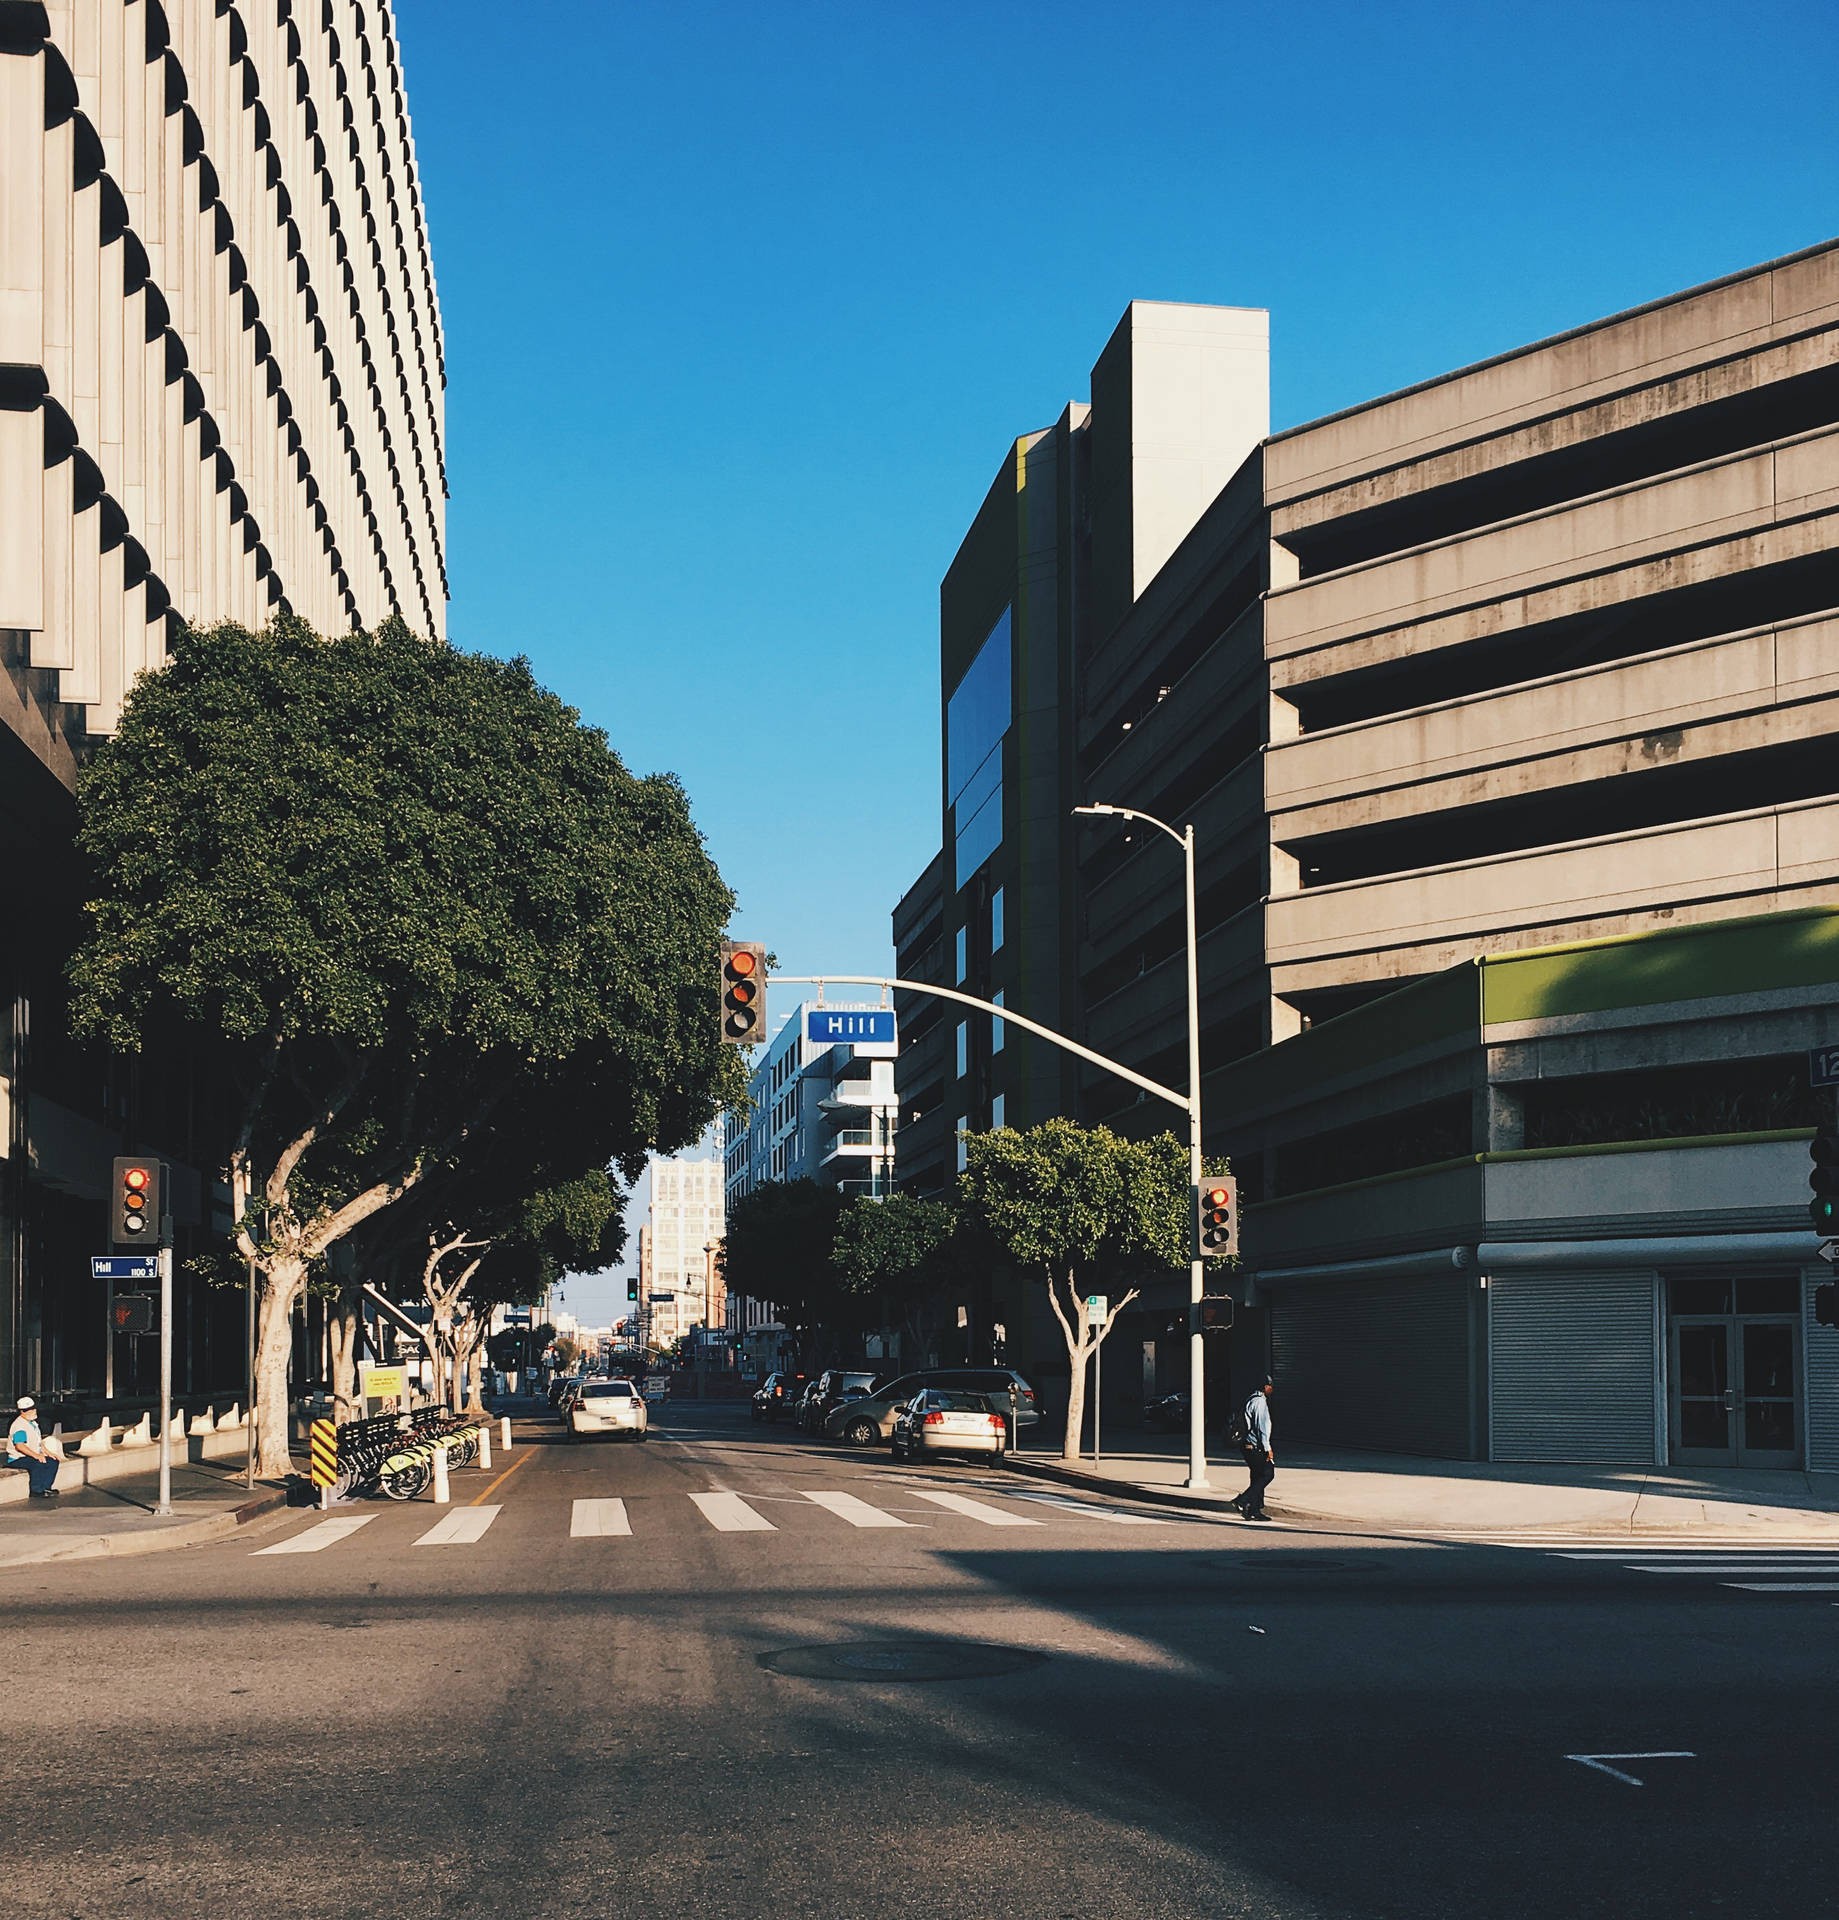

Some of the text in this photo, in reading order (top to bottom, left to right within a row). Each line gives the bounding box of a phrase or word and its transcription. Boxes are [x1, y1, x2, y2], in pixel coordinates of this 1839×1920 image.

[828, 1016, 876, 1034] Hill
[145, 1257, 154, 1266] St
[95, 1261, 112, 1273] Hill
[130, 1268, 154, 1277] 1100 S
